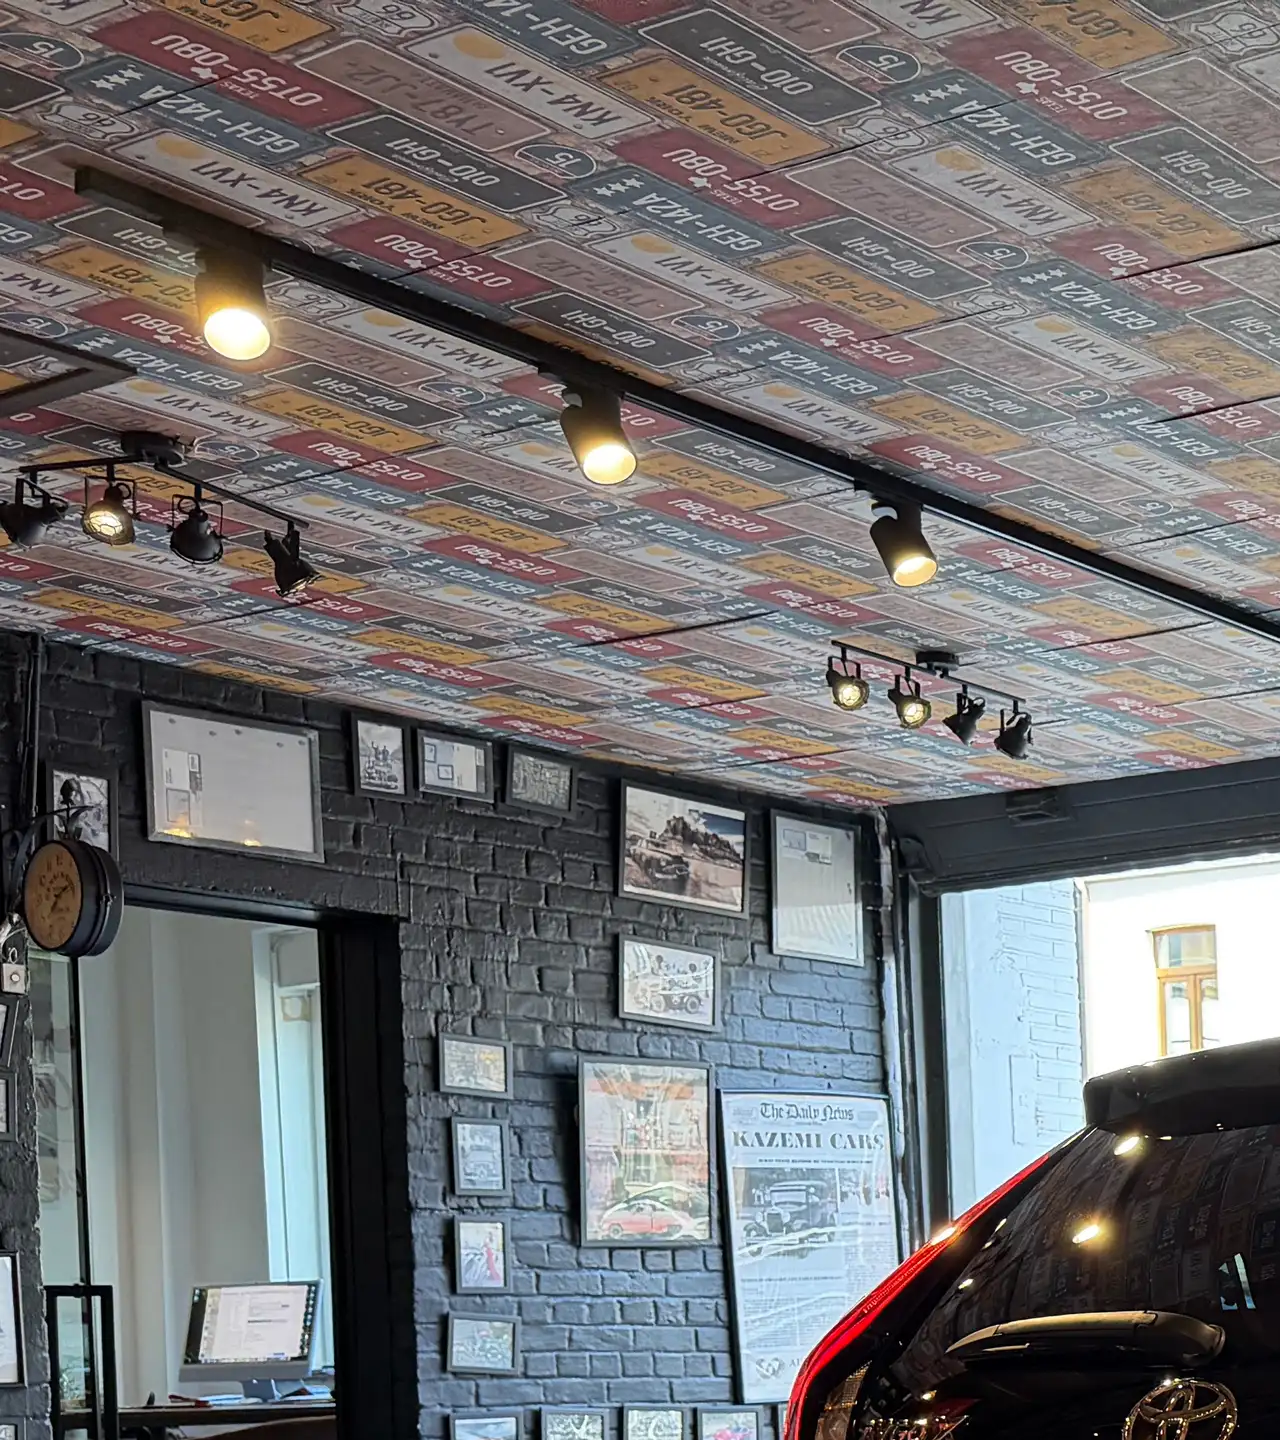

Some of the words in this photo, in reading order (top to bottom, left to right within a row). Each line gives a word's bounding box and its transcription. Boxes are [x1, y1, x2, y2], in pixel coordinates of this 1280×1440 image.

[23, 40, 65, 58] 15
[867, 53, 906, 71] 15
[544, 152, 581, 167] 15
[983, 247, 1017, 261] 15
[18, 317, 52, 329] 15
[760, 1102, 784, 1121] The
[785, 1103, 820, 1121] Daily
[821, 1104, 854, 1122] News
[732, 1131, 822, 1149] KAZEMI
[830, 1133, 884, 1150] CARS
